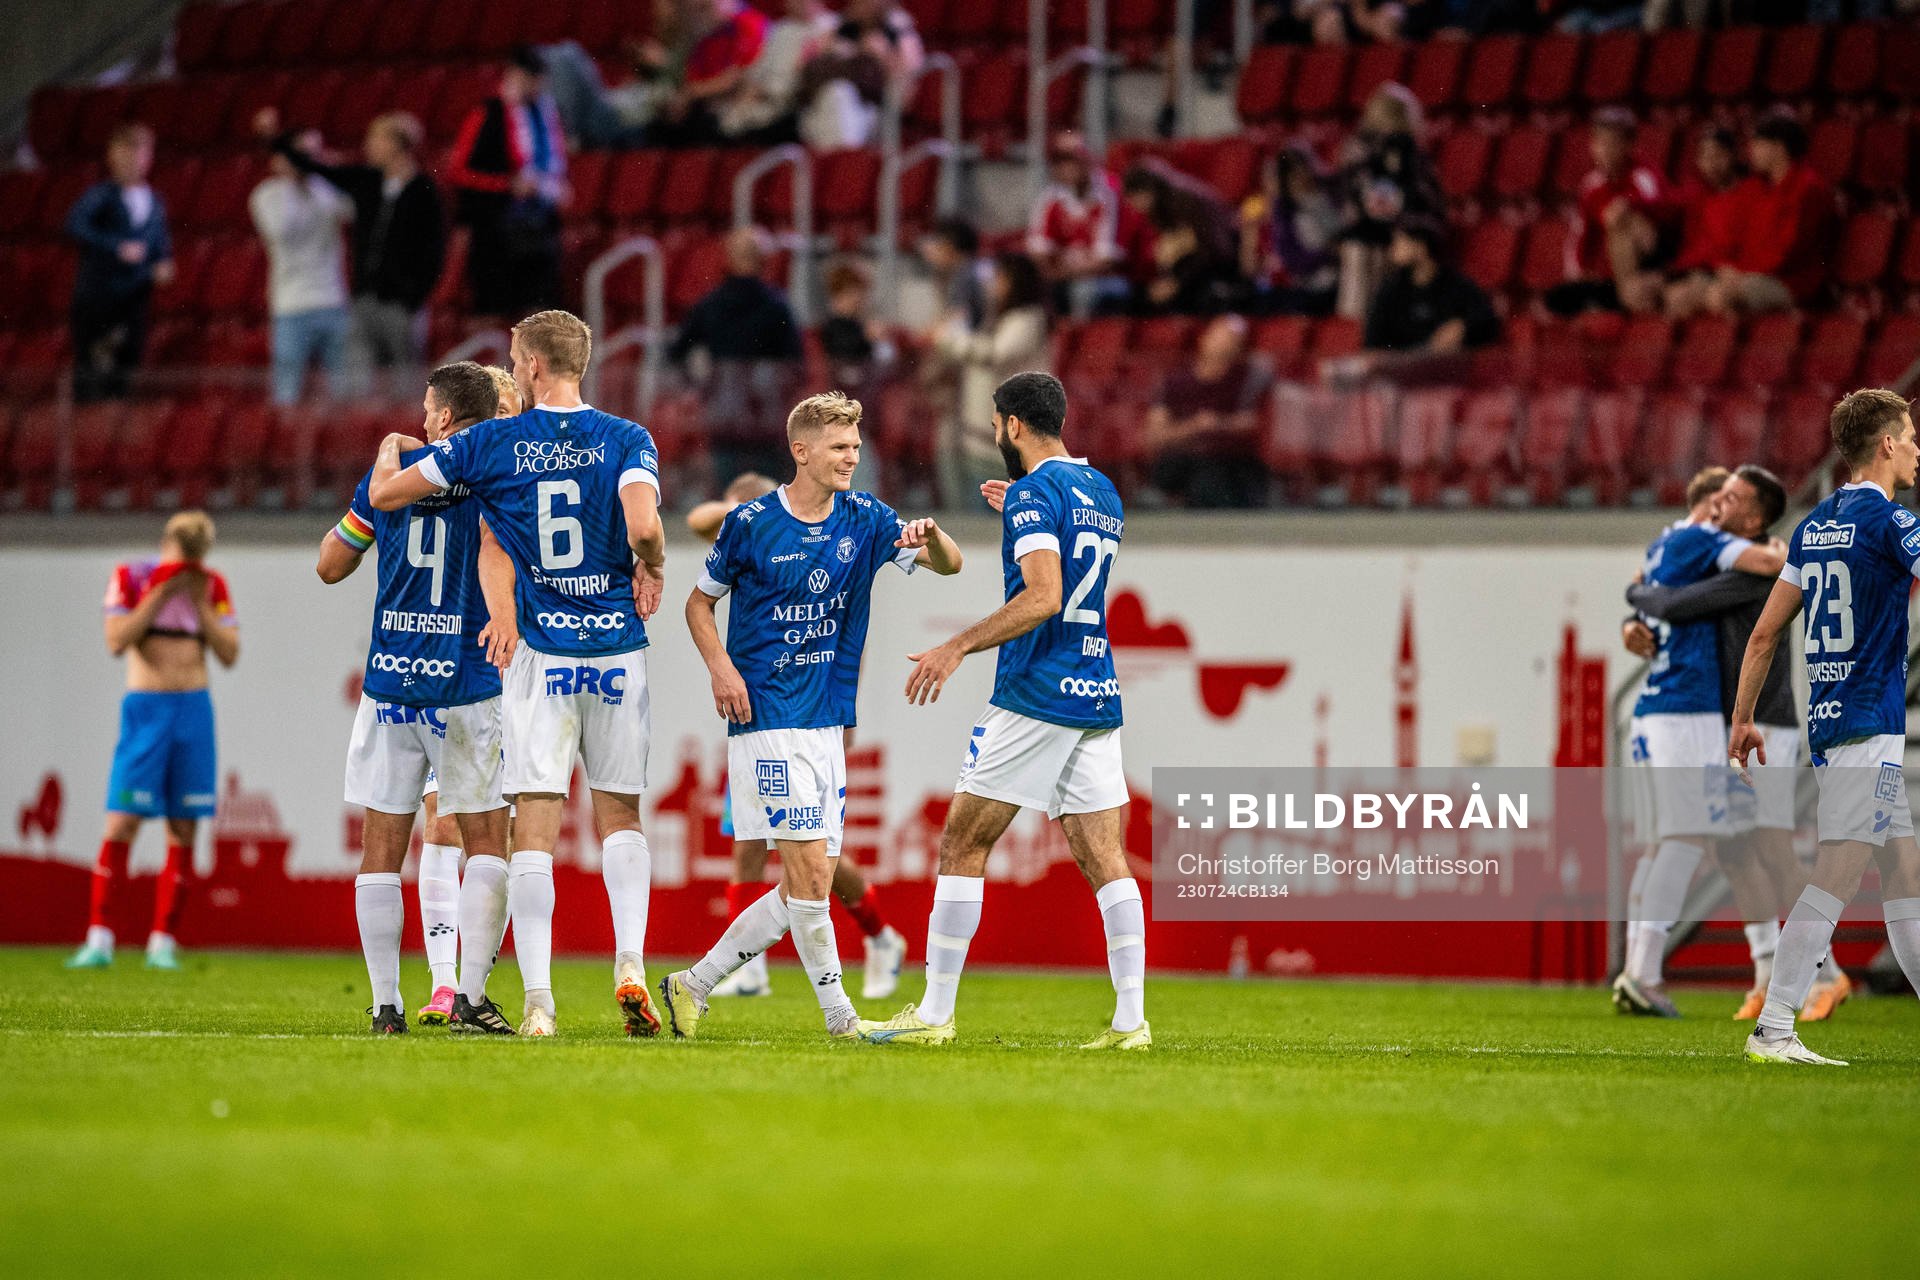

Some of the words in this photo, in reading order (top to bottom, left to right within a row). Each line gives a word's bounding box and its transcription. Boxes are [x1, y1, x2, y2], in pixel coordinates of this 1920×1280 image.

[514, 440, 605, 457] OSCAR
[513, 448, 606, 476] JACOBSON
[537, 480, 584, 570] 6
[1012, 510, 1041, 528] MVB
[407, 517, 446, 606] 4
[772, 554, 800, 564] CRAFT
[1800, 560, 1855, 655] 23
[381, 610, 462, 635] ANDERSSON
[603, 697, 623, 706] Rail
